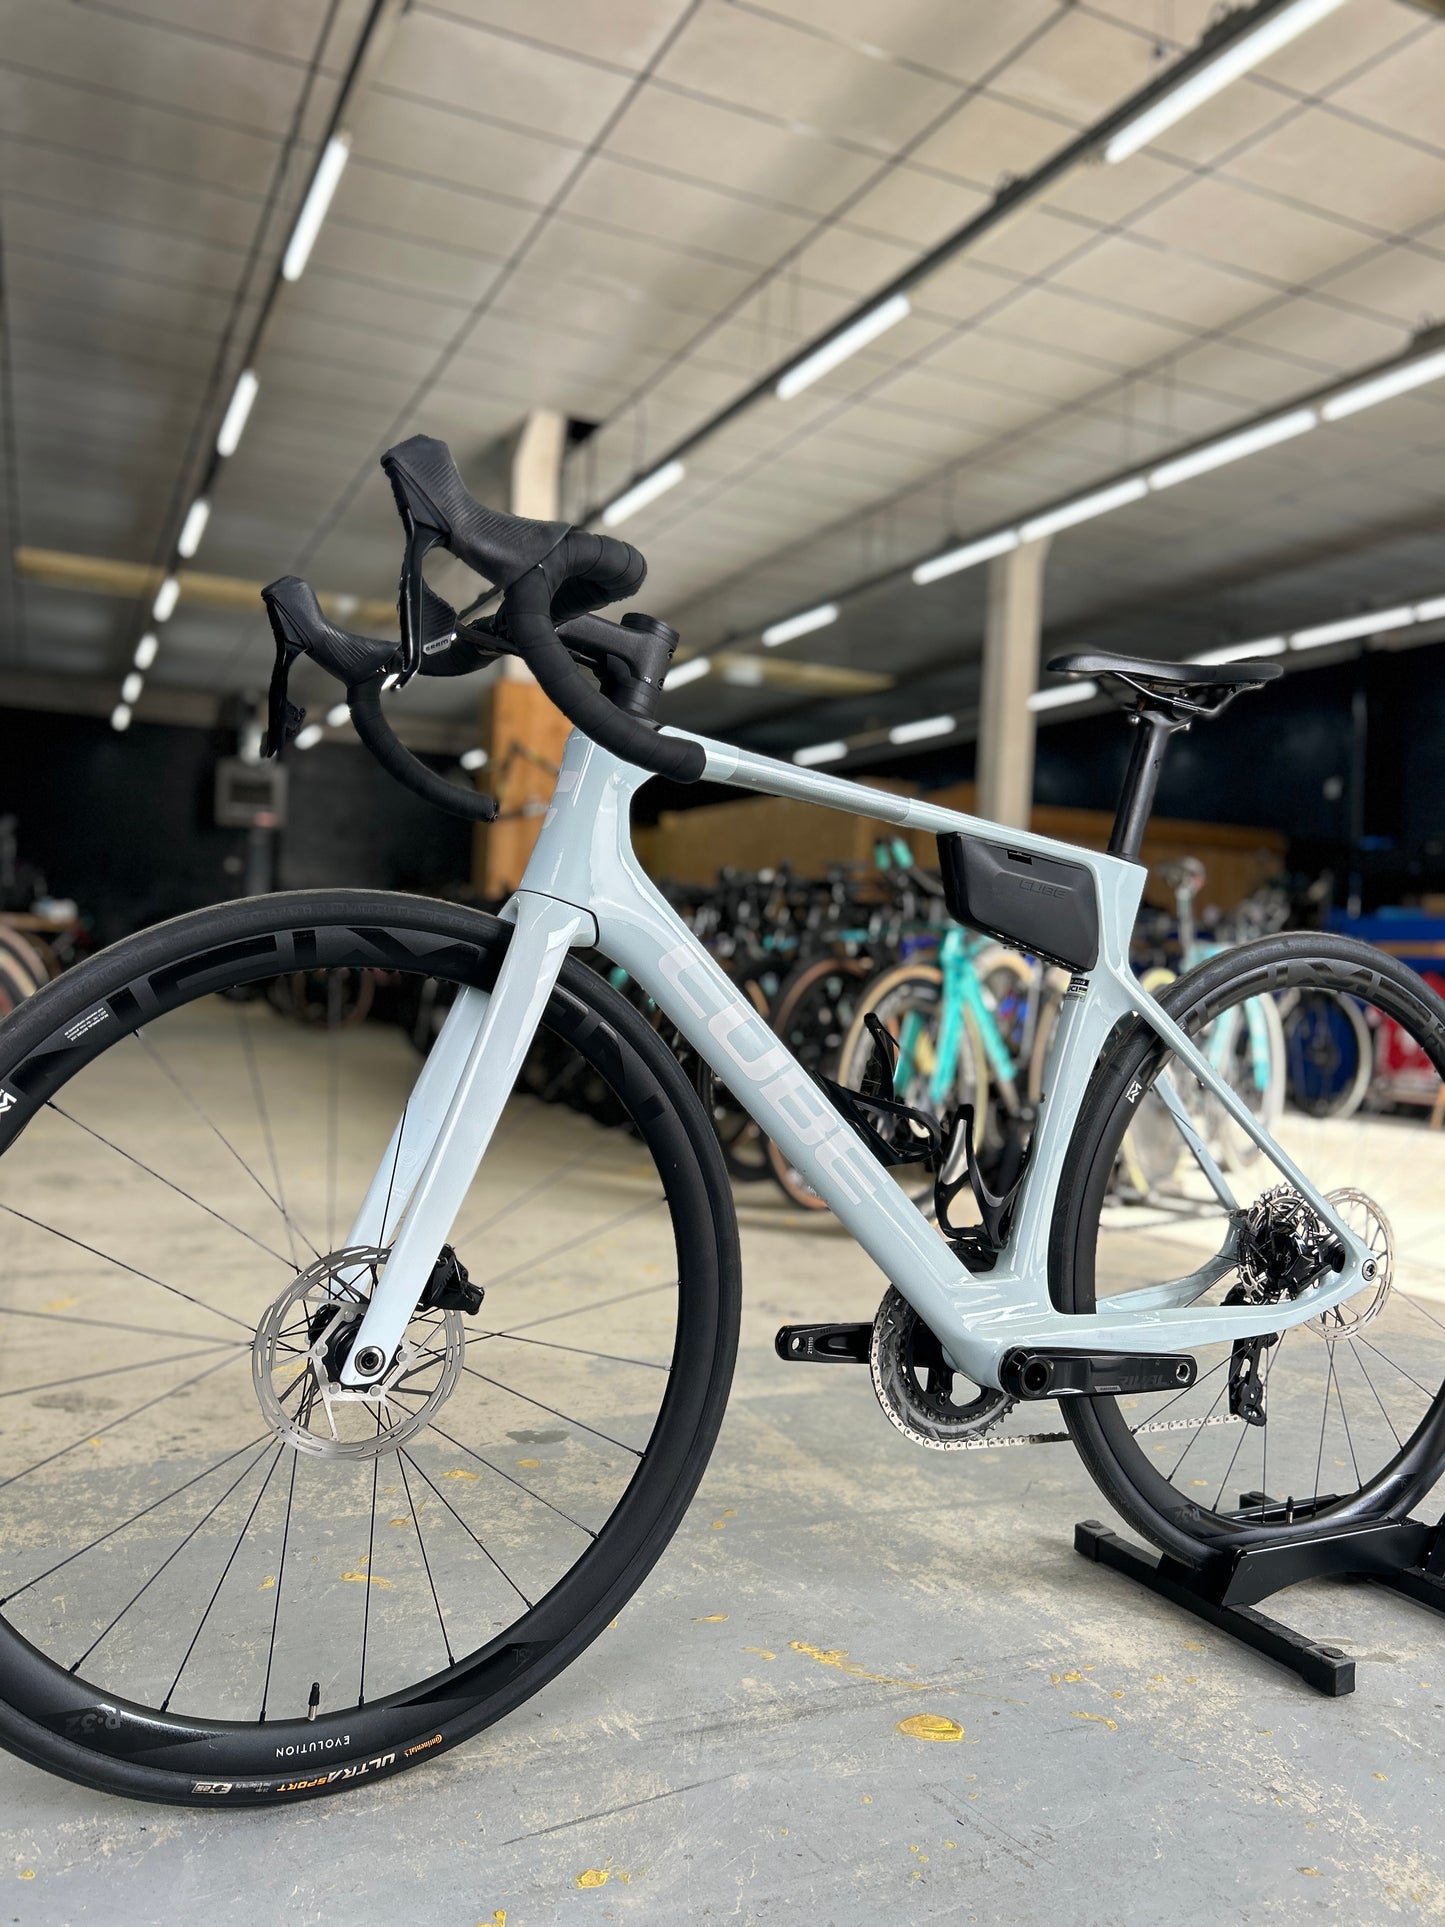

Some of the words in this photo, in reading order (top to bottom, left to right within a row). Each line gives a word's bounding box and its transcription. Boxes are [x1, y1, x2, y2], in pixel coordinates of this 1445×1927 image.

[1019, 879, 1069, 898] CUBE
[659, 942, 889, 1206] CUBE
[275, 1735, 350, 1757] EVOLUTION
